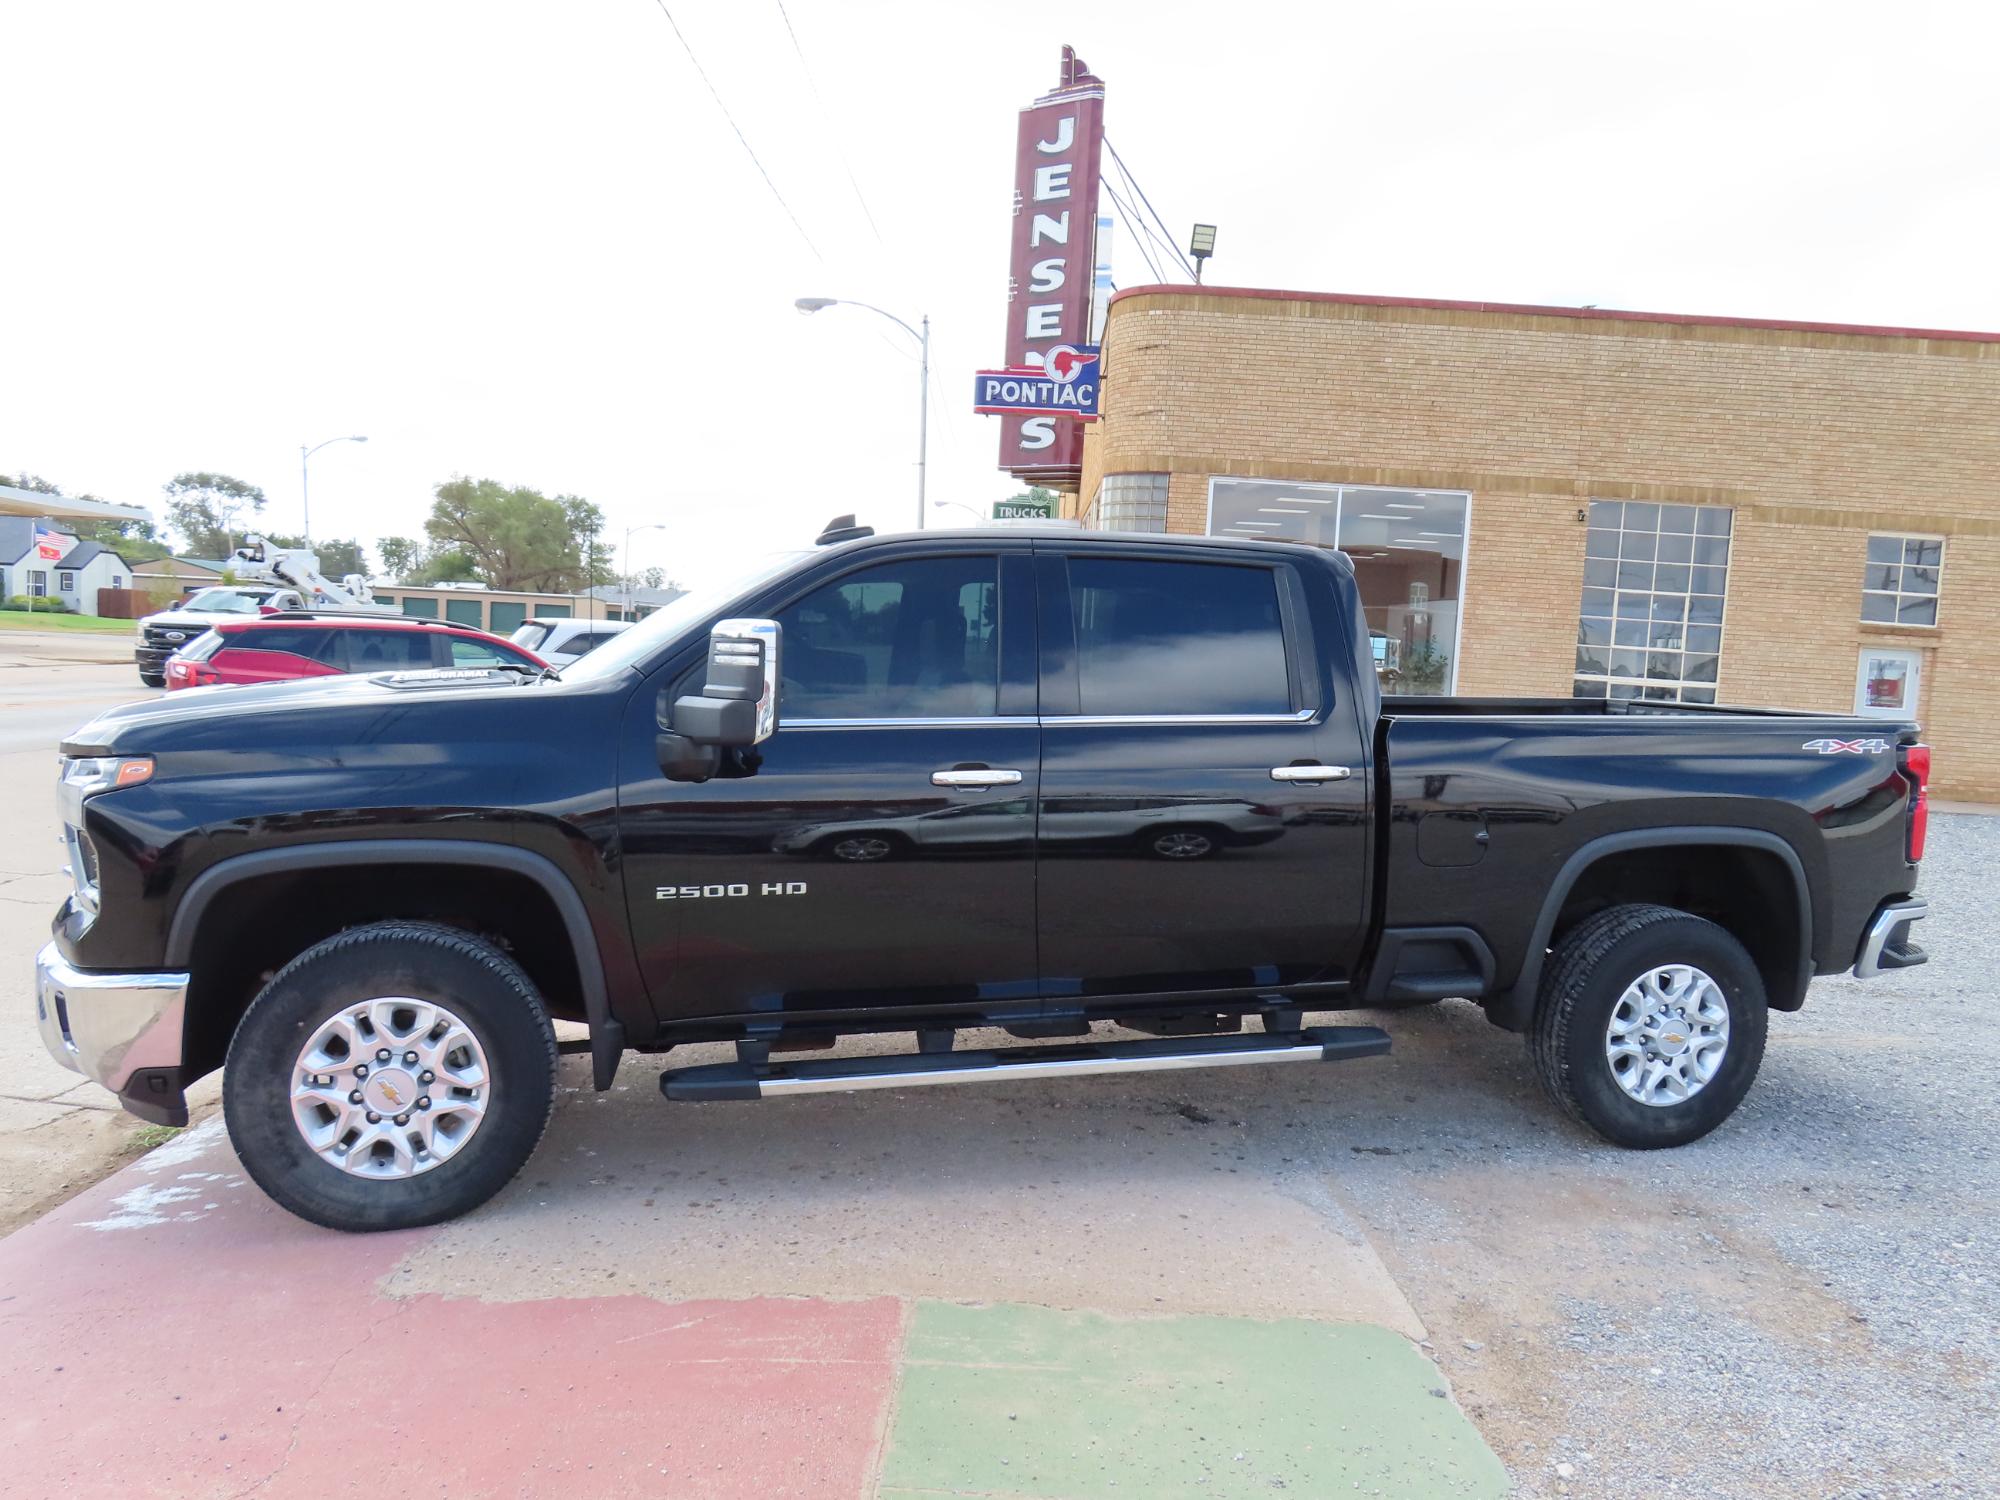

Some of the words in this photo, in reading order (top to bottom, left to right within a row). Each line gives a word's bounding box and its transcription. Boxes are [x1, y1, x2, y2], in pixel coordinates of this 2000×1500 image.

[985, 380, 1093, 406] PONTIAC
[998, 506, 1047, 519] TRUCKS
[432, 669, 490, 679] DURAMAX
[656, 883, 749, 900] 2500
[761, 881, 807, 896] HD
